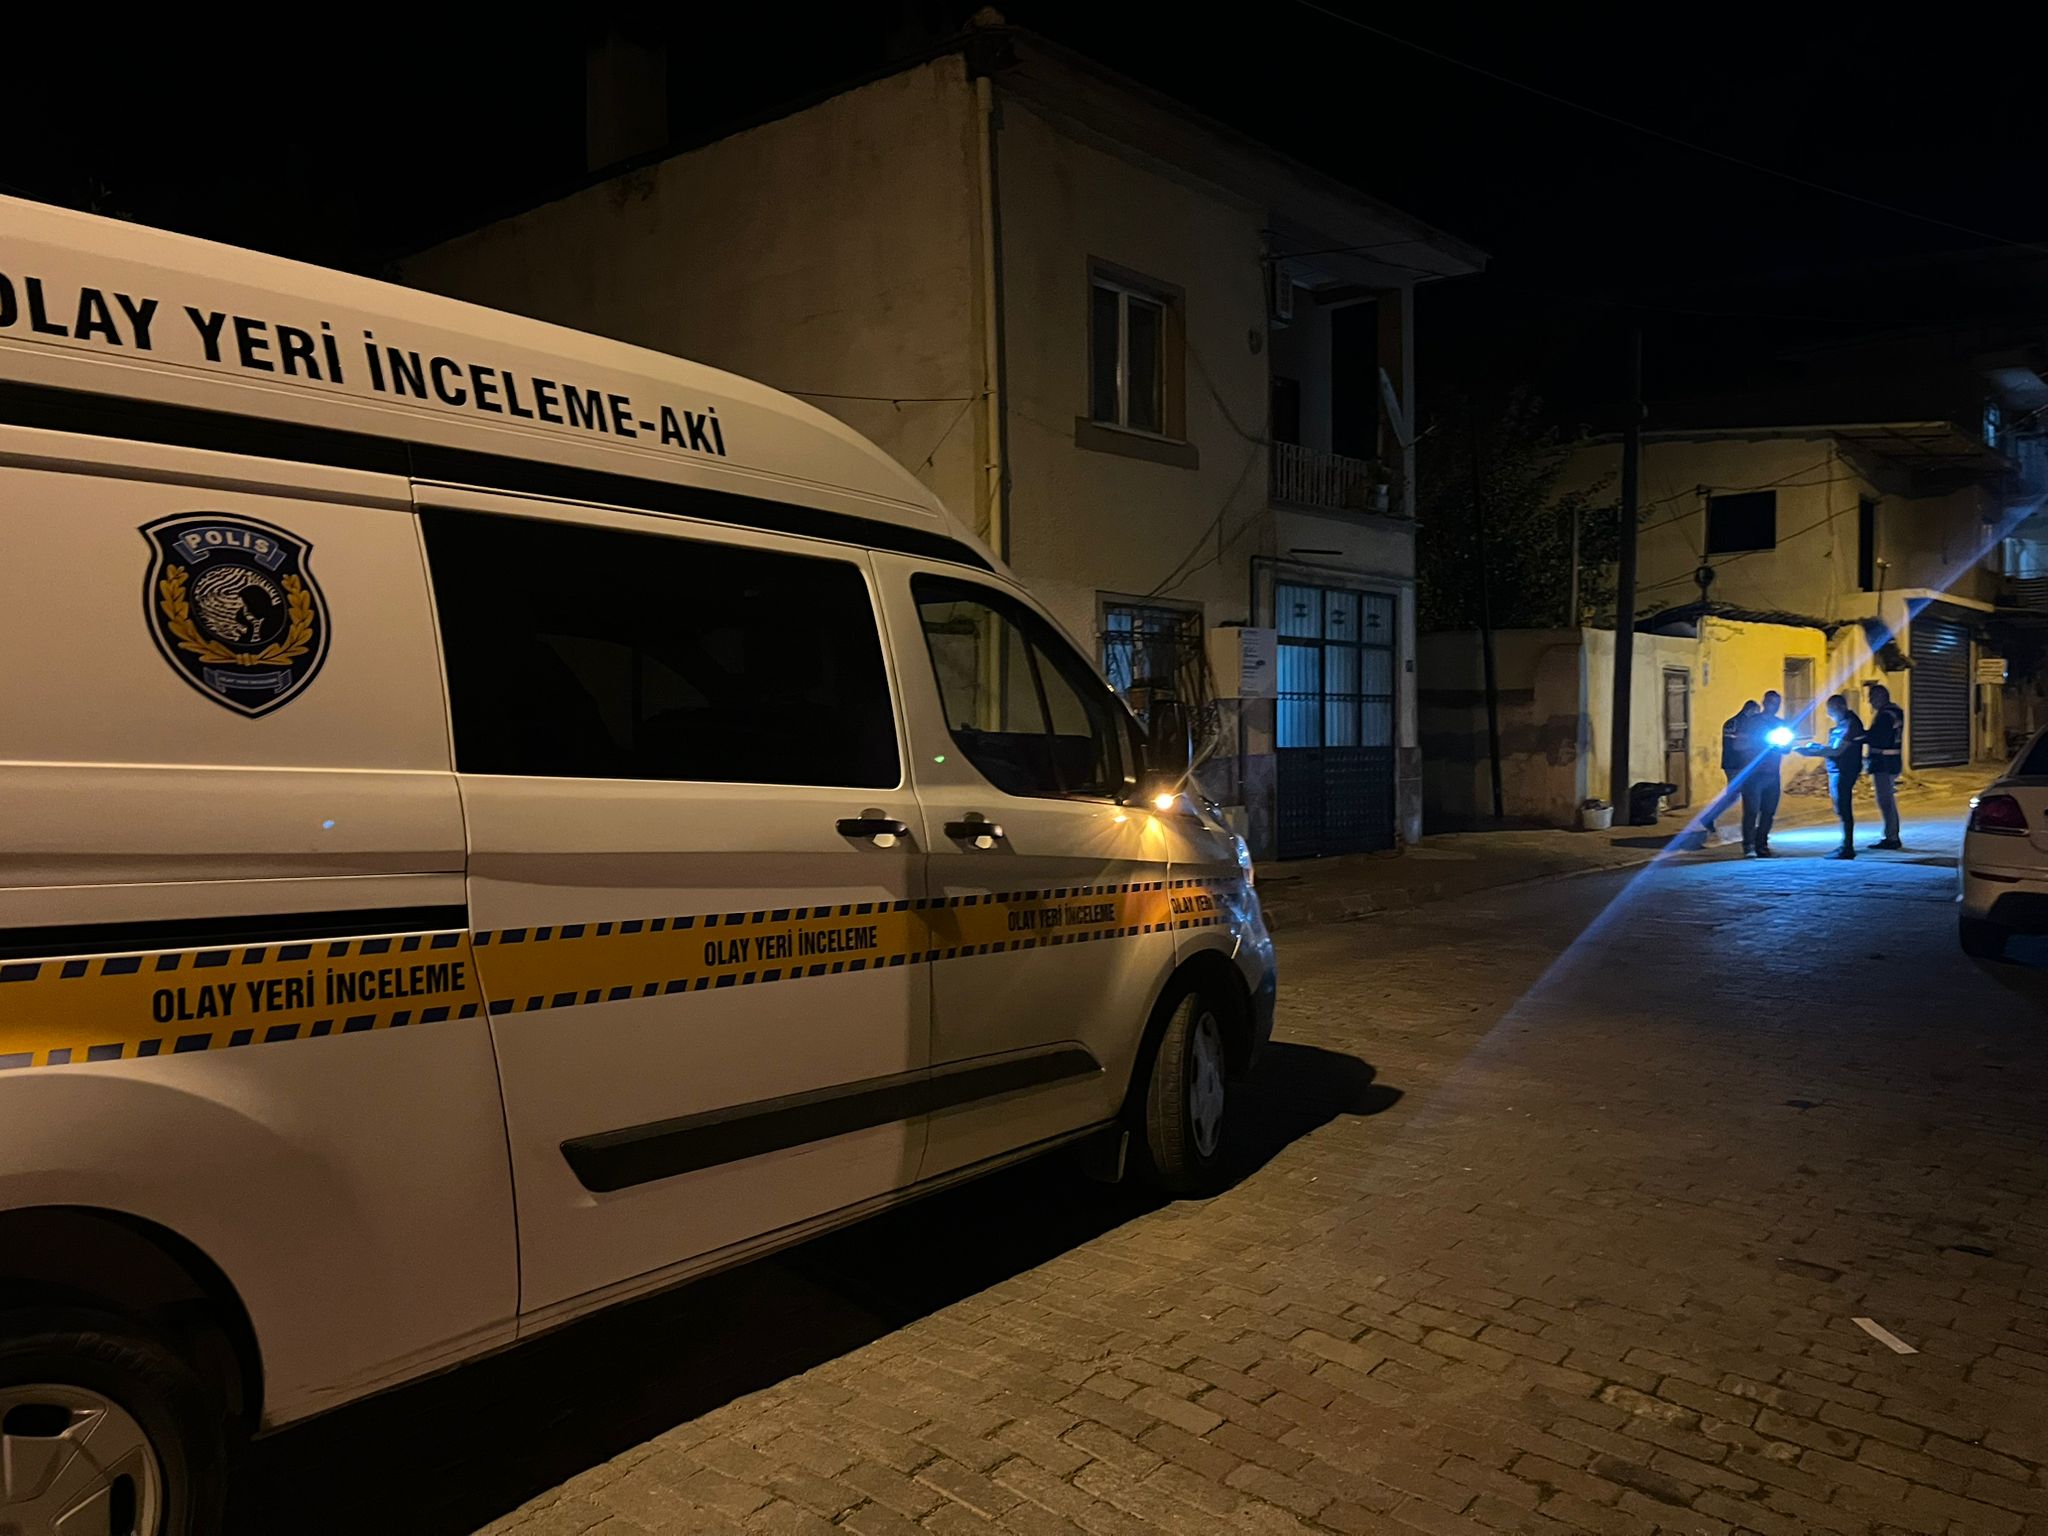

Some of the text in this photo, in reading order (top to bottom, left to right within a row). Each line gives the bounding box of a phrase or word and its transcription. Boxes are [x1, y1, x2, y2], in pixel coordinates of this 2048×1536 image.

[183, 306, 343, 383] YERİ
[363, 330, 727, 456] İNCELEME-AKİ
[184, 531, 270, 554] POLİS
[1008, 910, 1036, 931] OLAY
[1039, 904, 1062, 928] YERİ
[704, 926, 877, 966] OLAY YERİ İNCELEME
[152, 962, 465, 1023] OLAY YERİ İNCELEME
